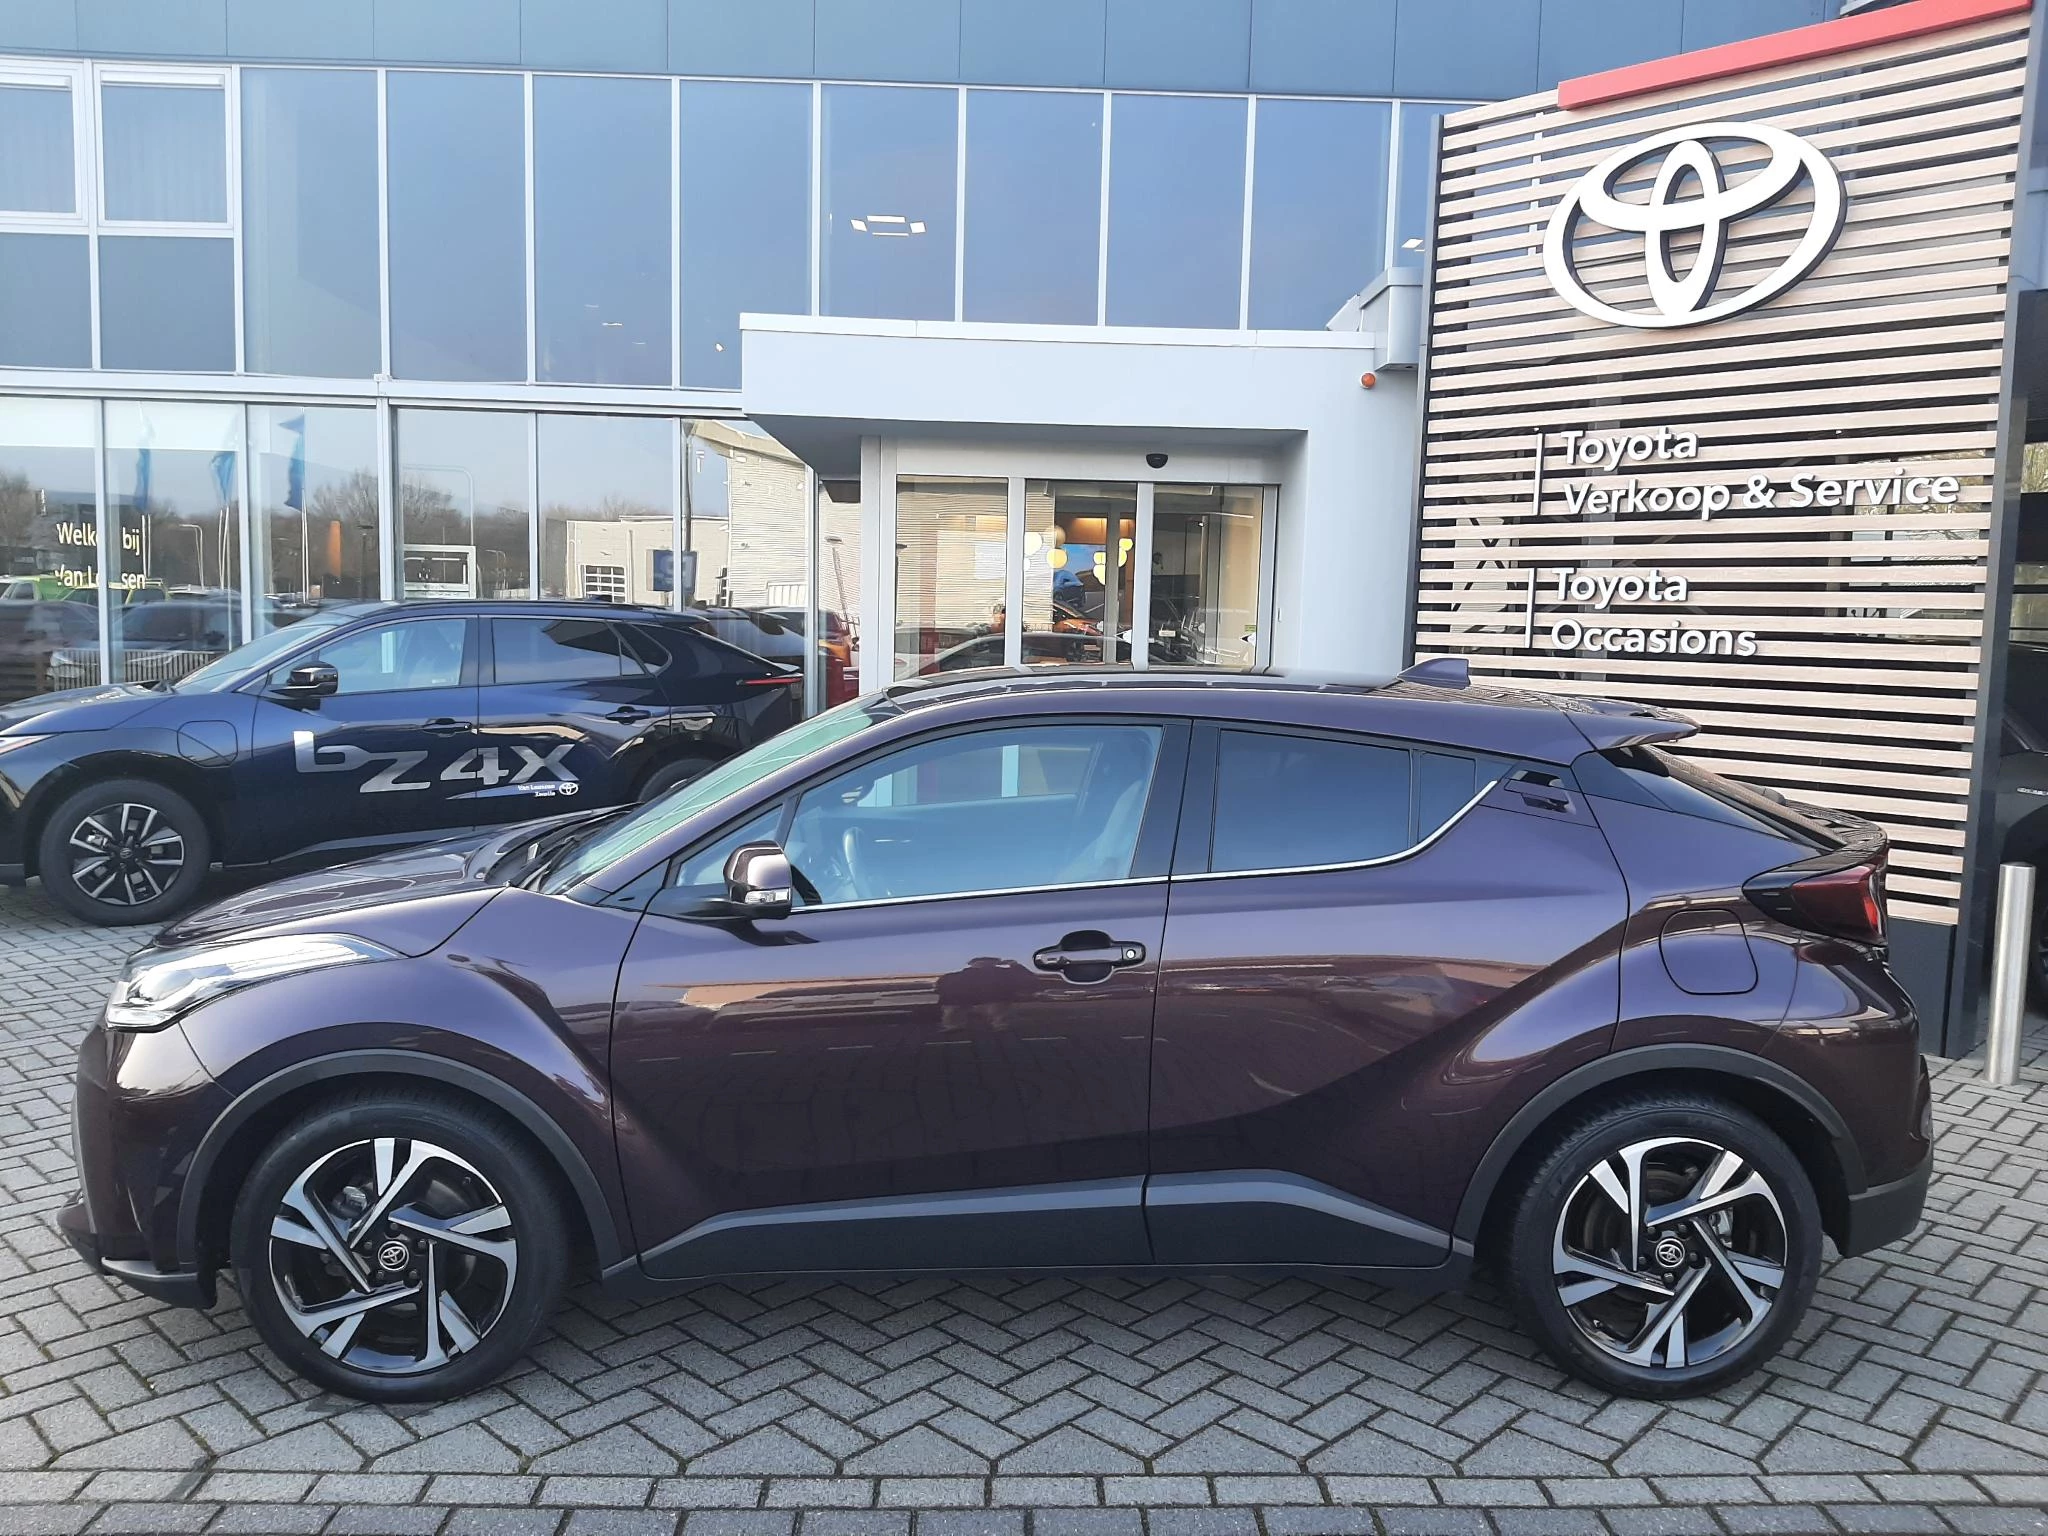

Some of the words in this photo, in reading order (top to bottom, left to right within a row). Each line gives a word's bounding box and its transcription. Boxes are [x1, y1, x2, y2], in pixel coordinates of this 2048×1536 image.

[1560, 426, 1698, 471] Toyota
[1563, 479, 1730, 520] Verkoop
[1743, 474, 1775, 508] &
[1789, 468, 1960, 507] Service
[56, 521, 99, 546] Welk
[122, 526, 140, 555] bij
[88, 565, 145, 589] Lsen
[1551, 567, 1689, 609] Toyota
[1551, 618, 1758, 656] Occasions
